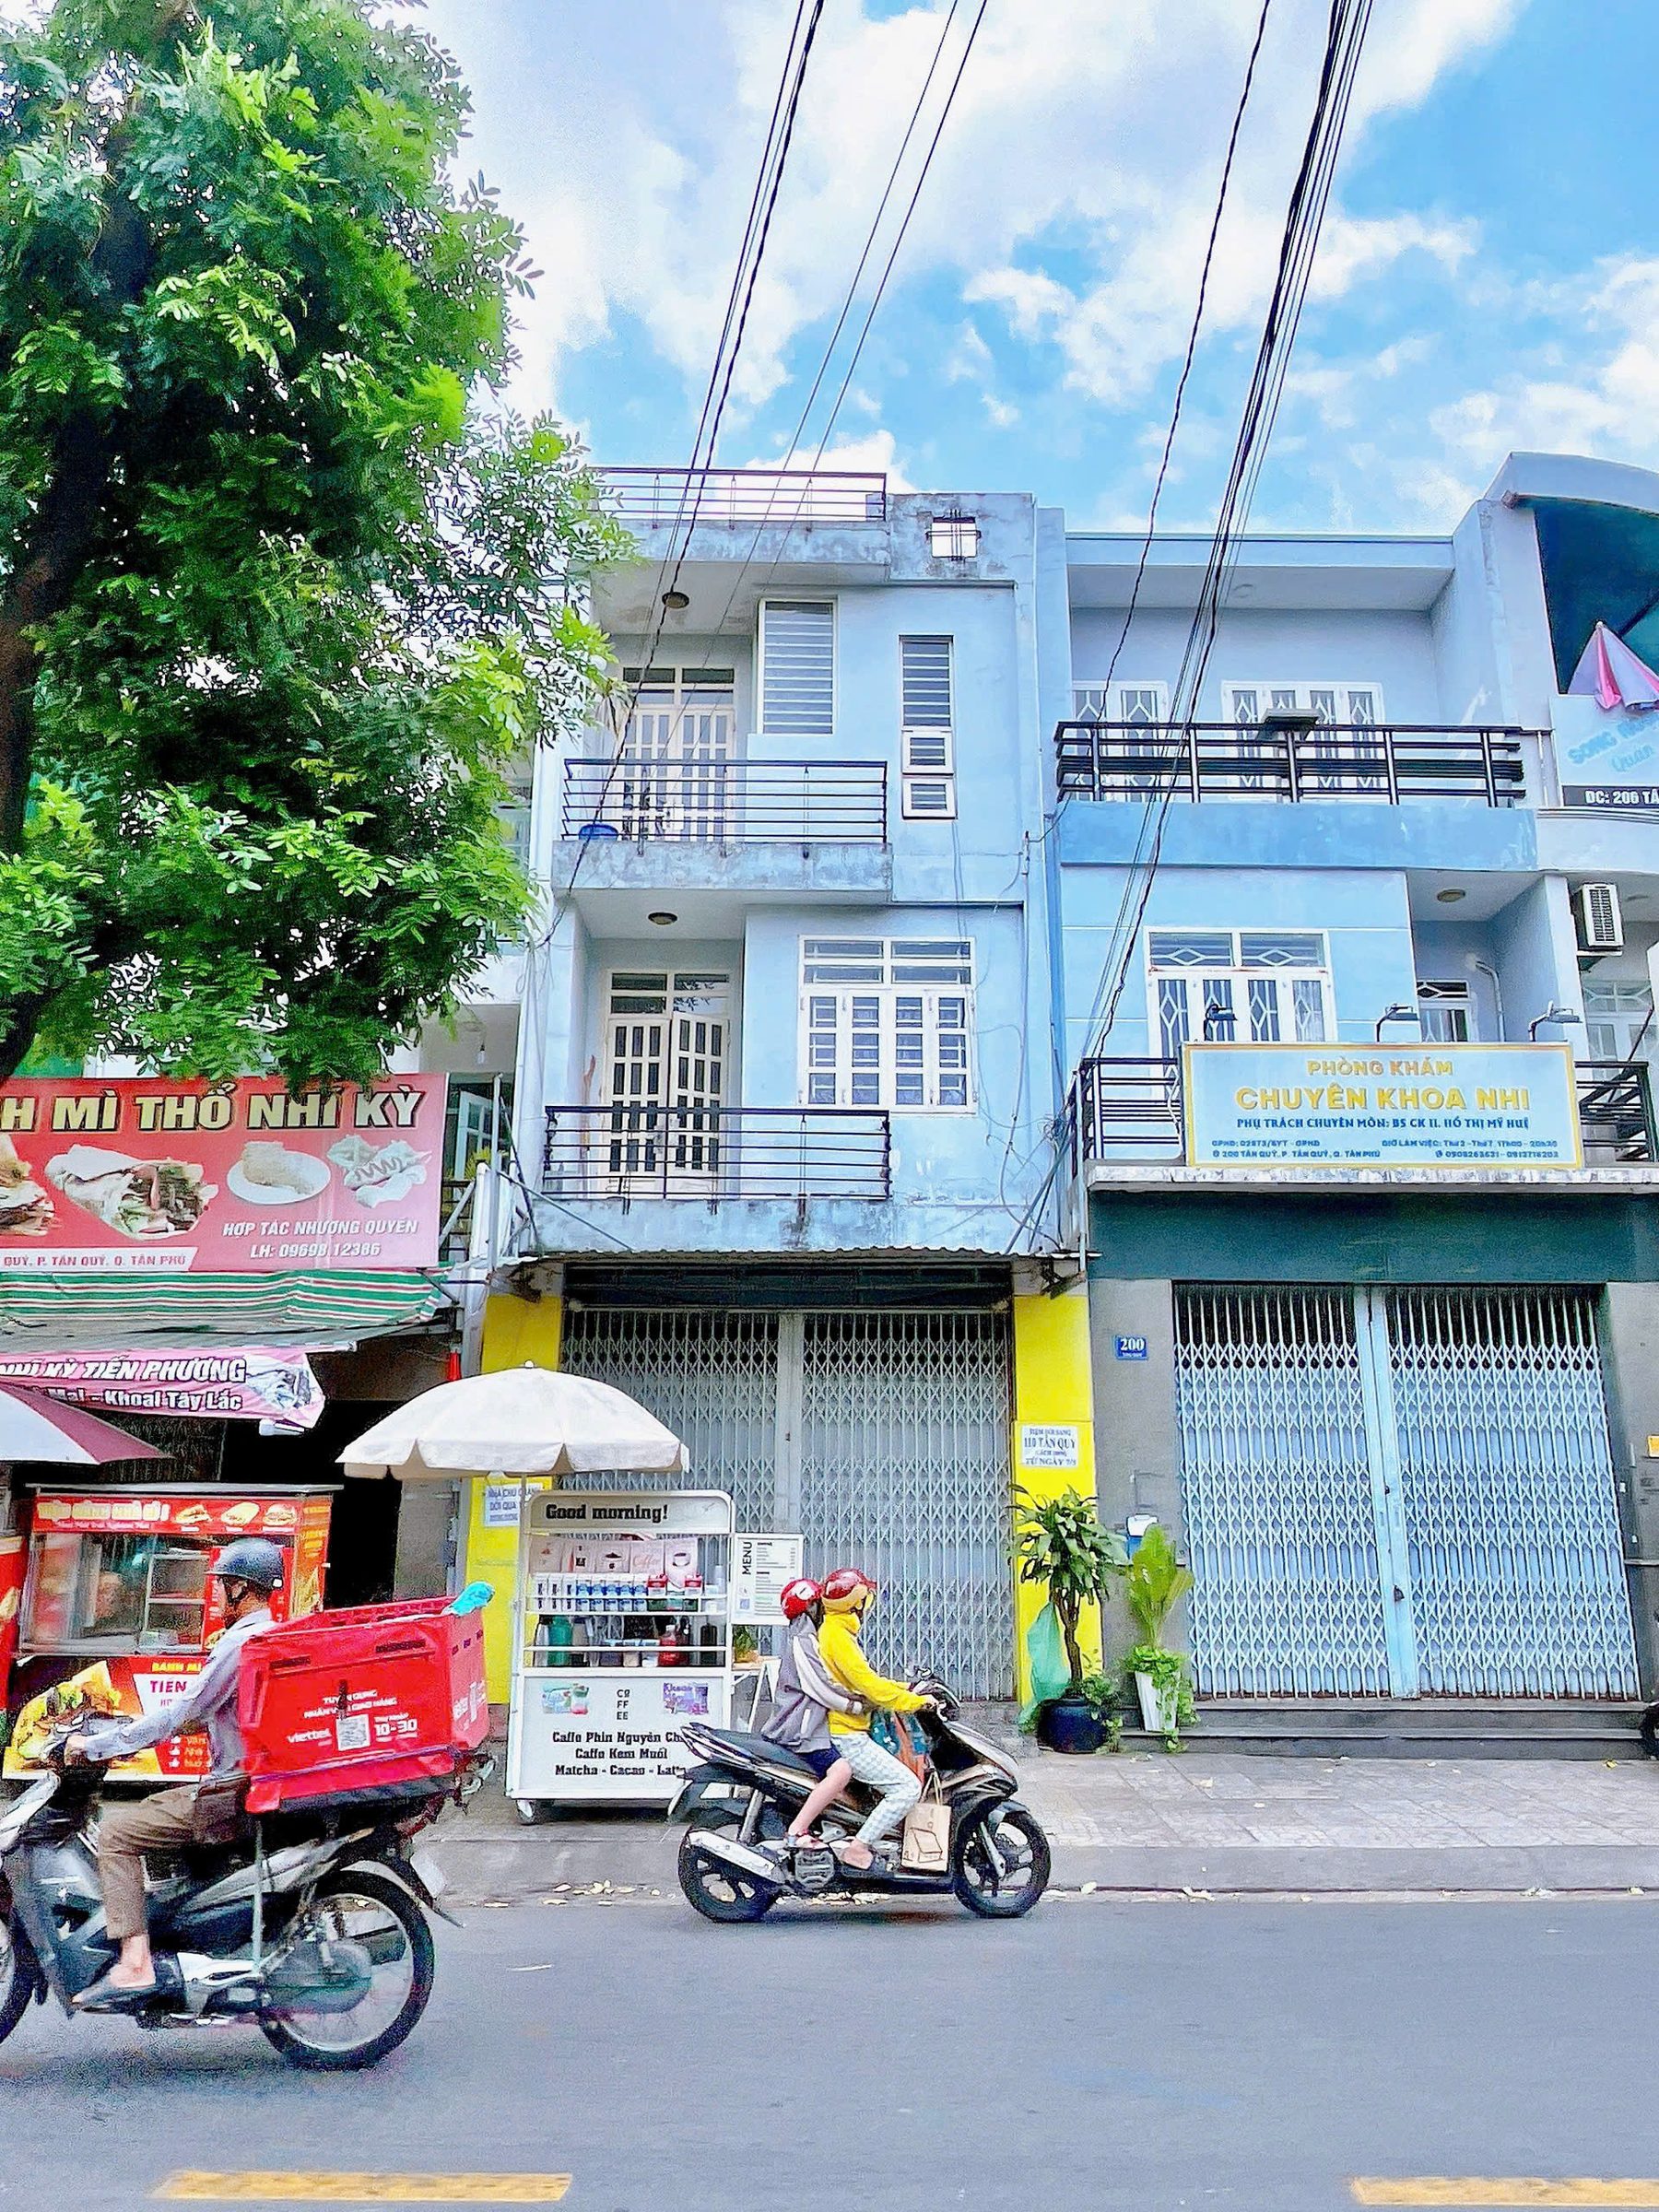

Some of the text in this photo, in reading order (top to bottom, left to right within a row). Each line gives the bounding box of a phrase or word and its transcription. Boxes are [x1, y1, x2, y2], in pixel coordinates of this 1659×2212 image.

[1612, 791, 1640, 805] 206
[1307, 1056, 1453, 1076] PHÒNG KHÁM
[1236, 1082, 1531, 1111] CHUYÊN KHOA NHI
[52, 1088, 118, 1131] MÌ
[135, 1082, 235, 1131] THỔ
[354, 1085, 425, 1128] KỲ
[1237, 1119, 1261, 1130] PHỤ
[1264, 1116, 1303, 1128] TRÁCH
[1307, 1116, 1354, 1128] CHUYÊN
[1393, 1119, 1406, 1128] BS
[1410, 1119, 1426, 1128] CK
[1465, 1119, 1485, 1130] THỊ
[1487, 1117, 1504, 1128] MỸ
[222, 1221, 255, 1240] HỢP
[259, 1218, 289, 1236] TÁC
[251, 1244, 275, 1259] LH:
[1120, 1337, 1145, 1351] 200
[140, 1357, 247, 1383] PHƯƠNG
[166, 1390, 202, 1412] Tây
[546, 1504, 667, 1524] Good morning!
[742, 1541, 752, 1575] MENU
[617, 1700, 629, 1709] FF
[617, 1712, 629, 1720] EE
[586, 1732, 612, 1743] Phin
[665, 1732, 685, 1743] Ch
[609, 1748, 635, 1759] Kem
[555, 1765, 598, 1775] Matcha
[610, 1765, 645, 1775] Cacao
